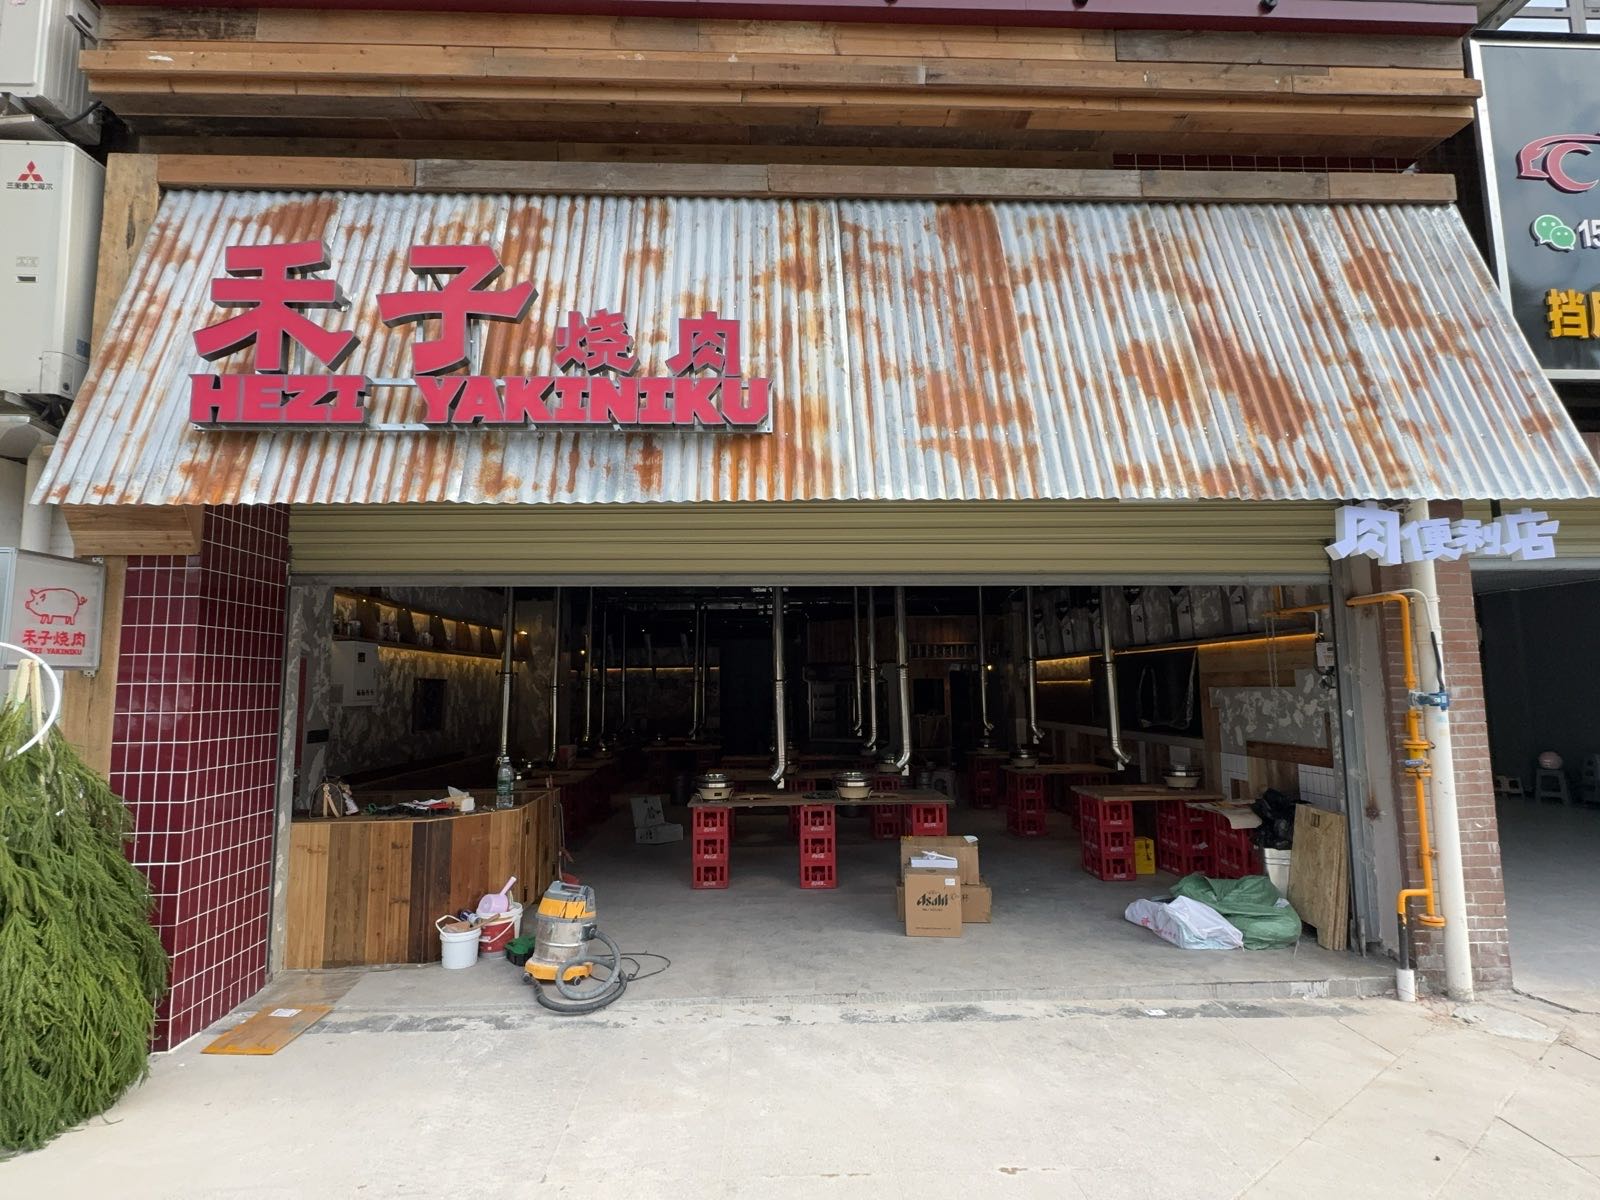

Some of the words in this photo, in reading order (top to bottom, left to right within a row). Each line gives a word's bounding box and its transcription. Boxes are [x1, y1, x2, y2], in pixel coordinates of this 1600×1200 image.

[189, 373, 366, 424] HEZI
[415, 375, 772, 425] YAKINIKU
[1325, 500, 1559, 566] 肉便利店
[22, 630, 86, 647] 禾子烧肉
[917, 893, 948, 907] Asahi
